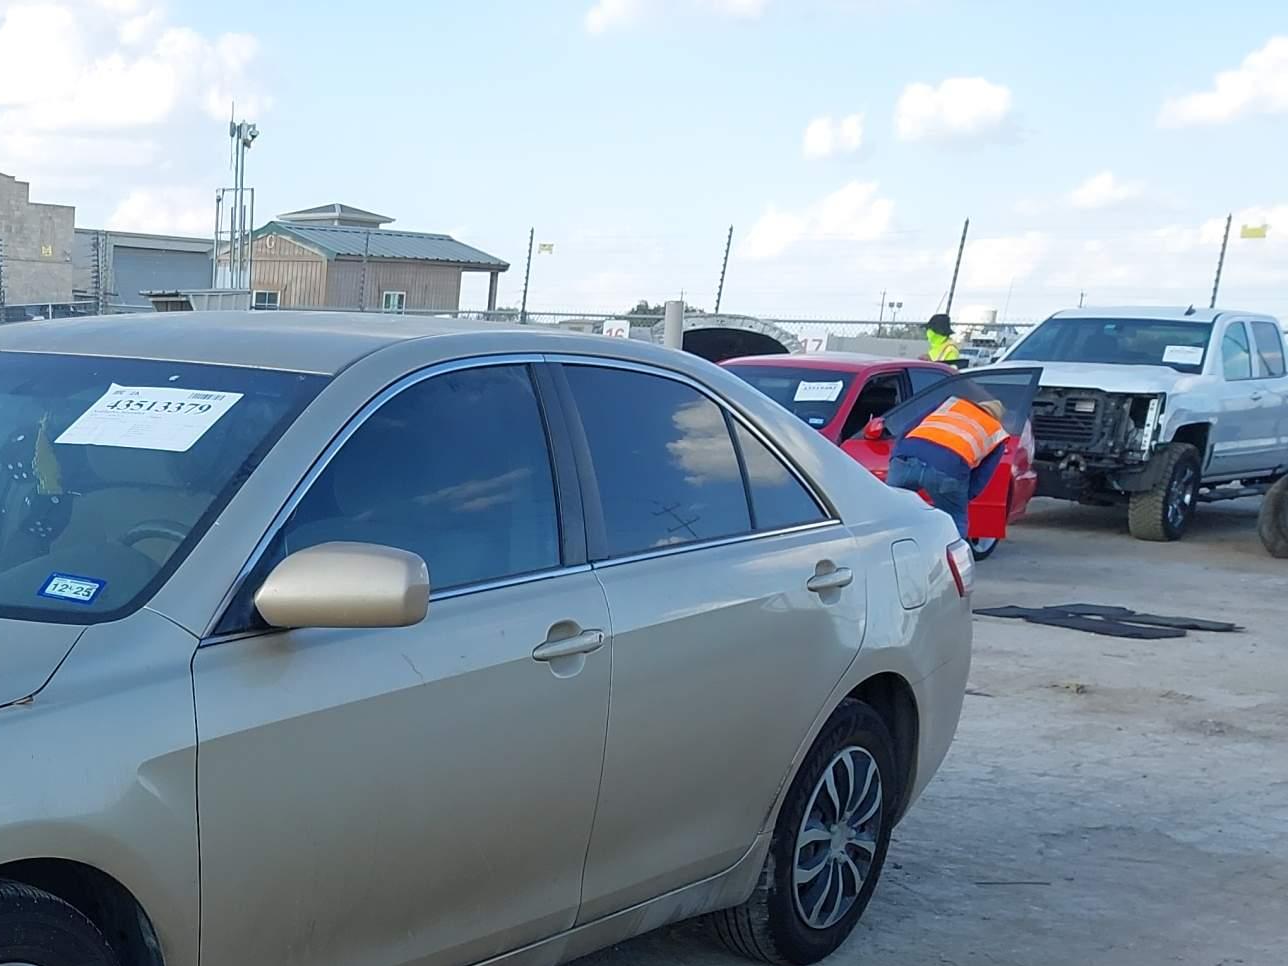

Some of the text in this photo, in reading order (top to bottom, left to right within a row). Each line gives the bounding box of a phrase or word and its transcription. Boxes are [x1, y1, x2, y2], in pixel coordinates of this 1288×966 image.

[800, 338, 823, 353] 17
[107, 399, 212, 416] 43513379
[51, 583, 92, 597] 12 25
